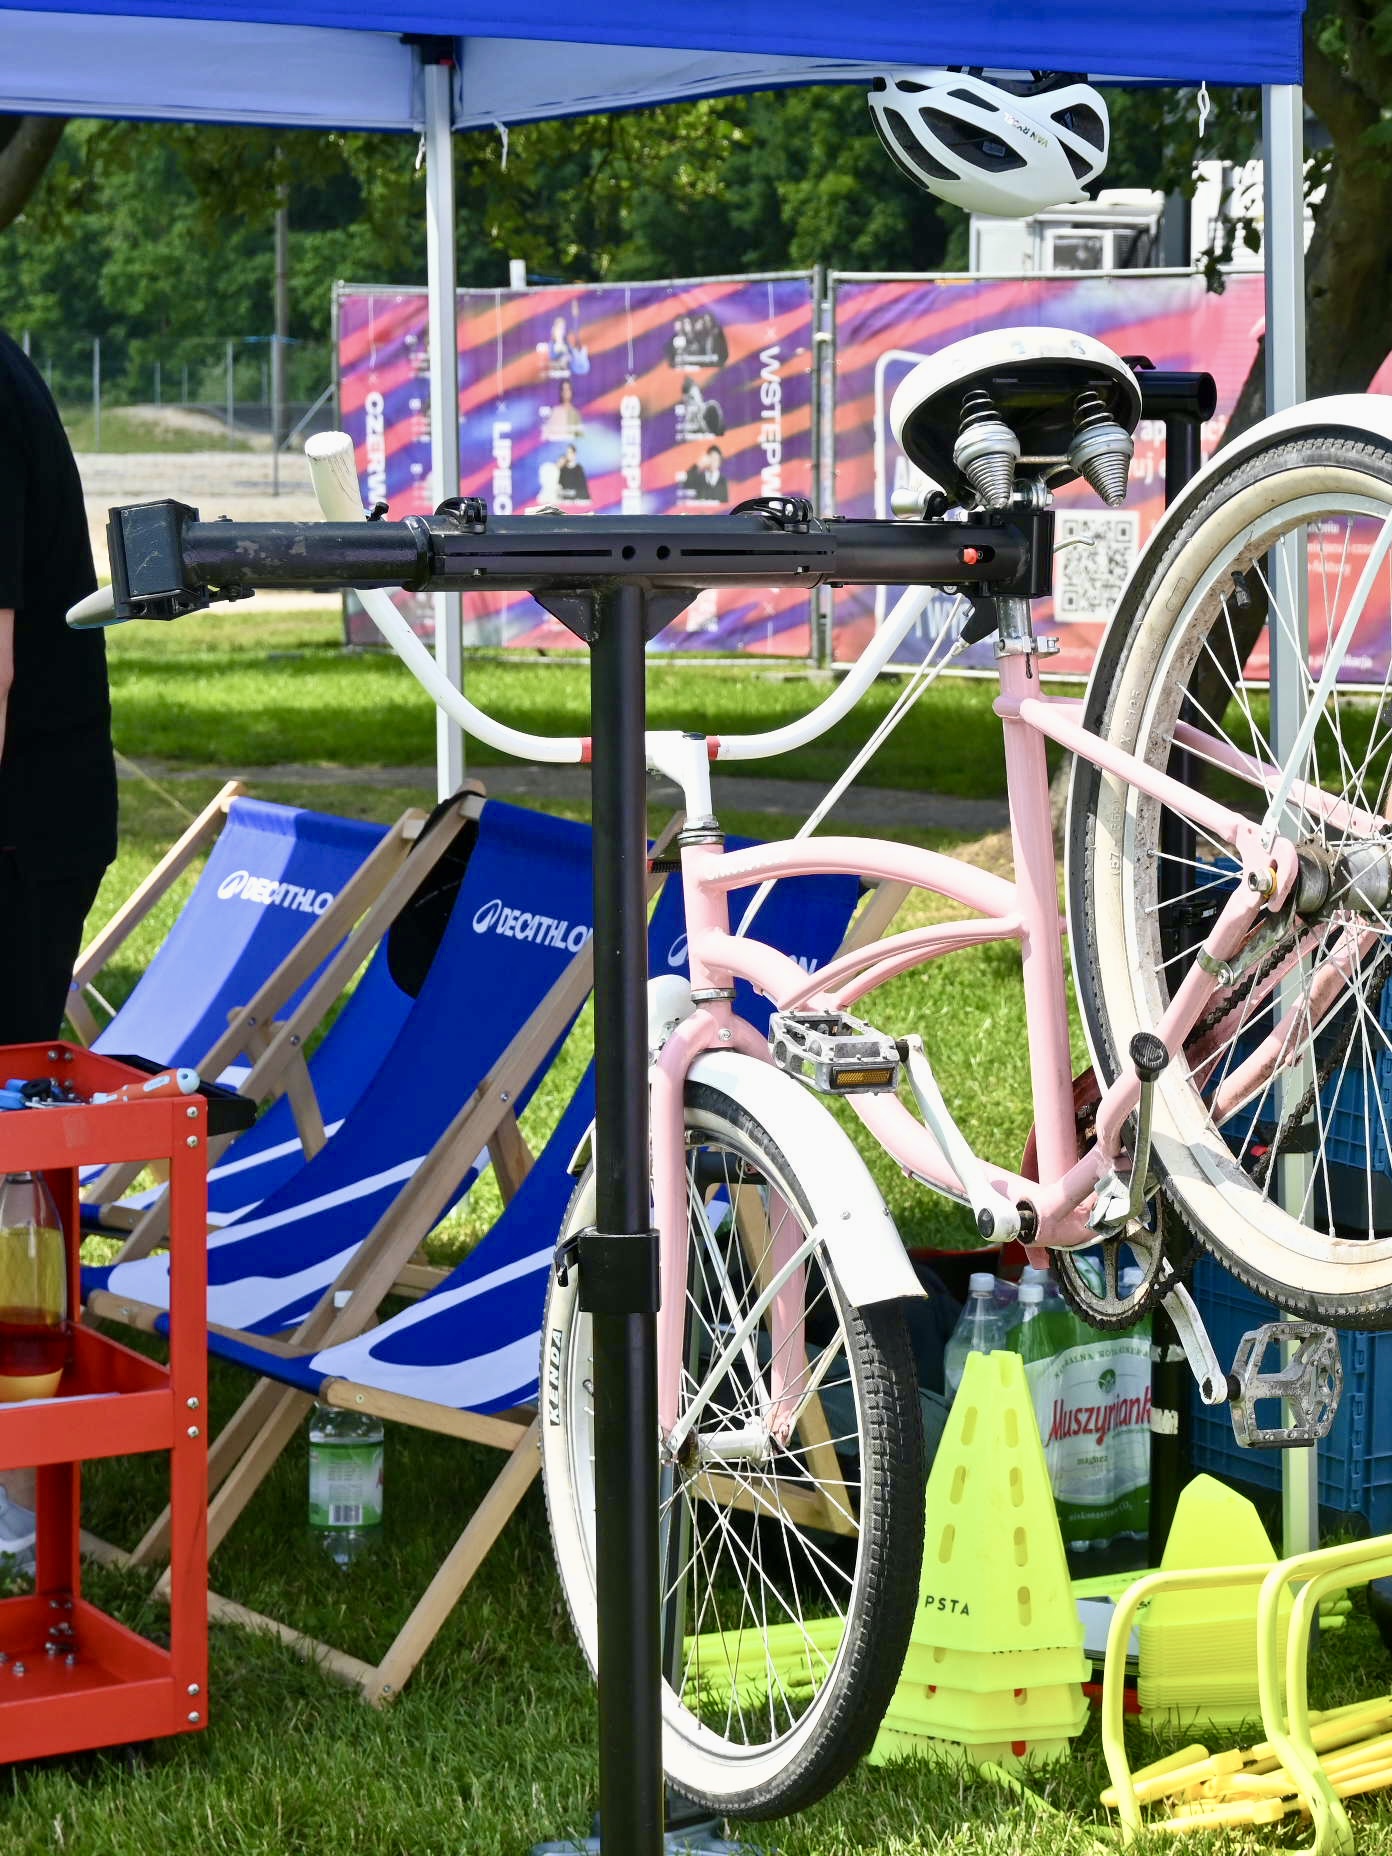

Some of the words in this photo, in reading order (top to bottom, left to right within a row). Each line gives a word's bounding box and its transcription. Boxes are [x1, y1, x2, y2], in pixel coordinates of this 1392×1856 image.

[620, 395, 642, 515] SIERPIE
[240, 876, 335, 915] DECATHLO
[496, 906, 593, 953] DECATHLO
[550, 1329, 562, 1426] KENDA
[1044, 1386, 1152, 1448] Muszyniank
[924, 1595, 970, 1616] PSTA
